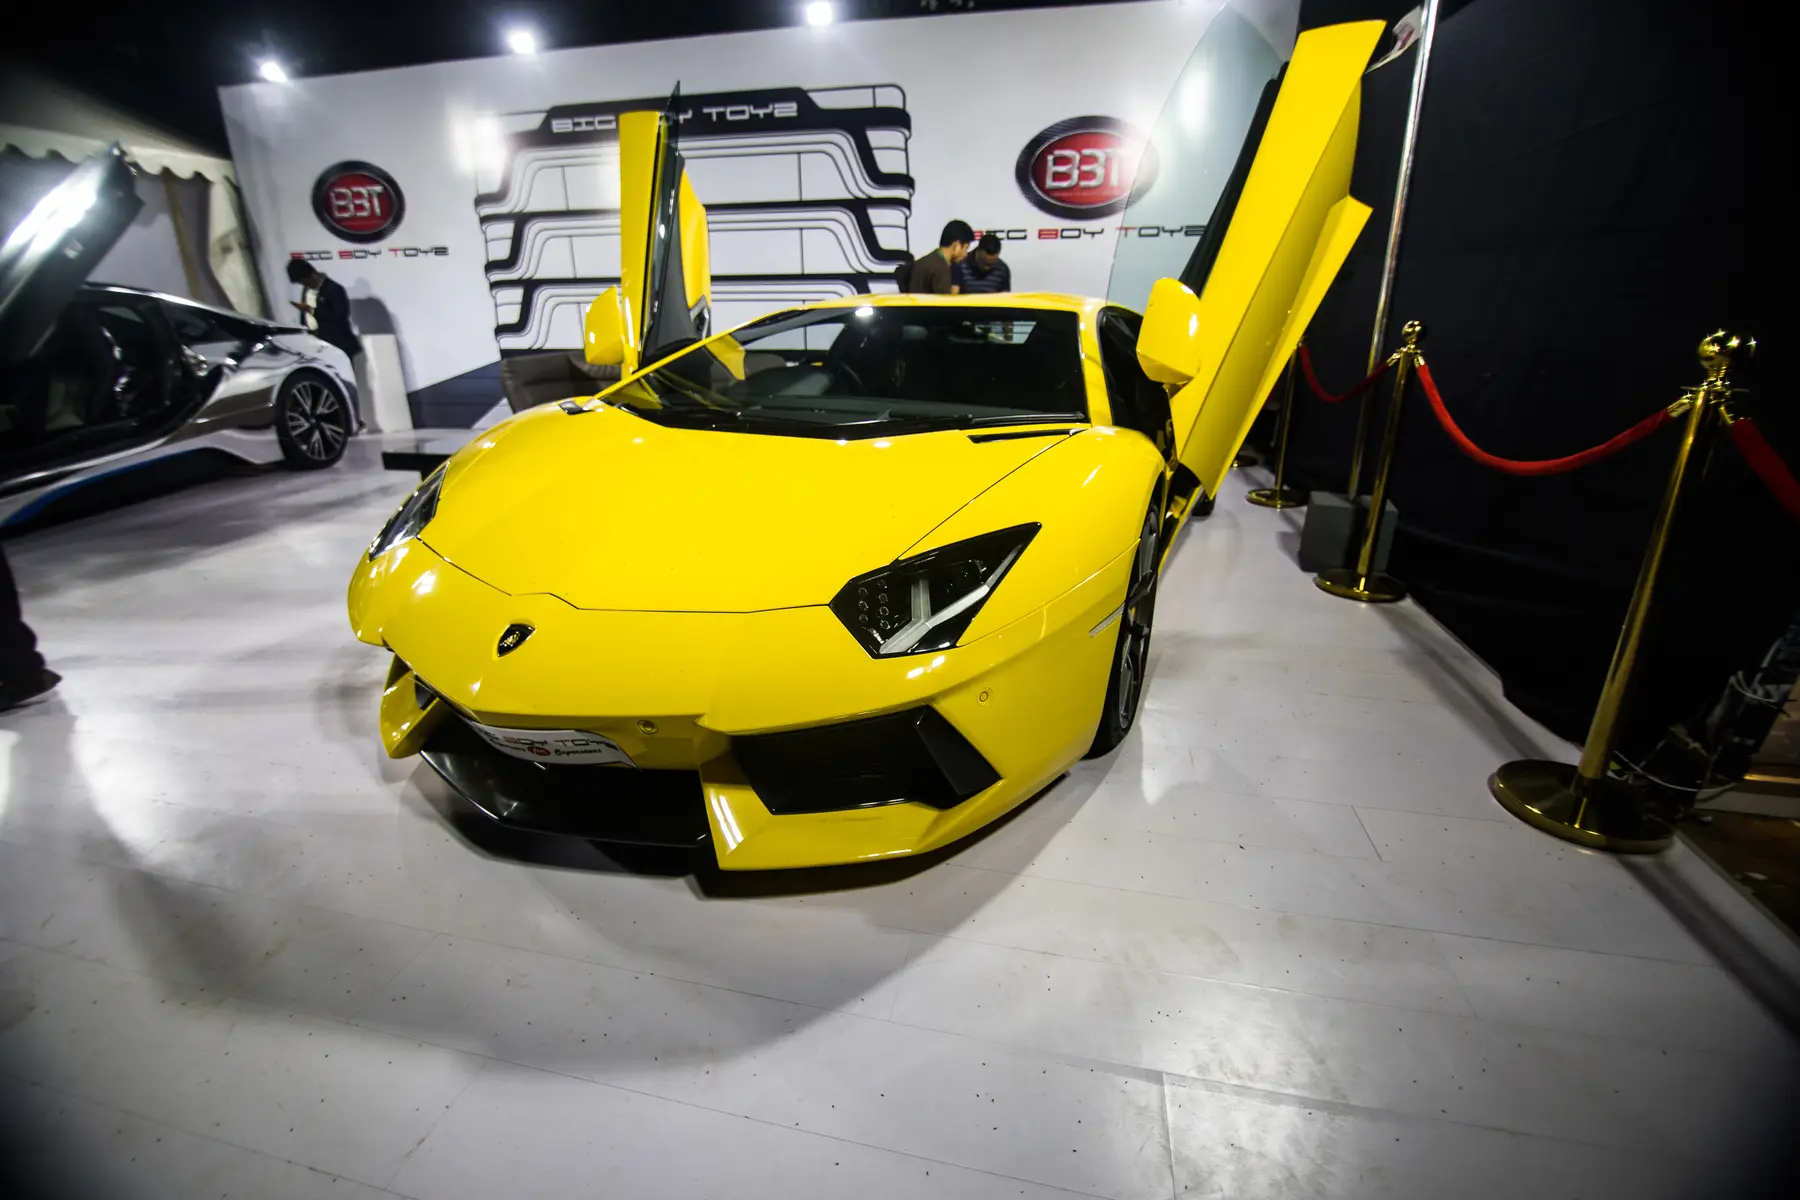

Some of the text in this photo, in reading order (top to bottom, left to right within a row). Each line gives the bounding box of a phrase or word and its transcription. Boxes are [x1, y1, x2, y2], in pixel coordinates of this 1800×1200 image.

[552, 115, 617, 133] BIG
[1038, 228, 1105, 240] BOY
[290, 251, 333, 261] BIG
[337, 248, 383, 260] BOY
